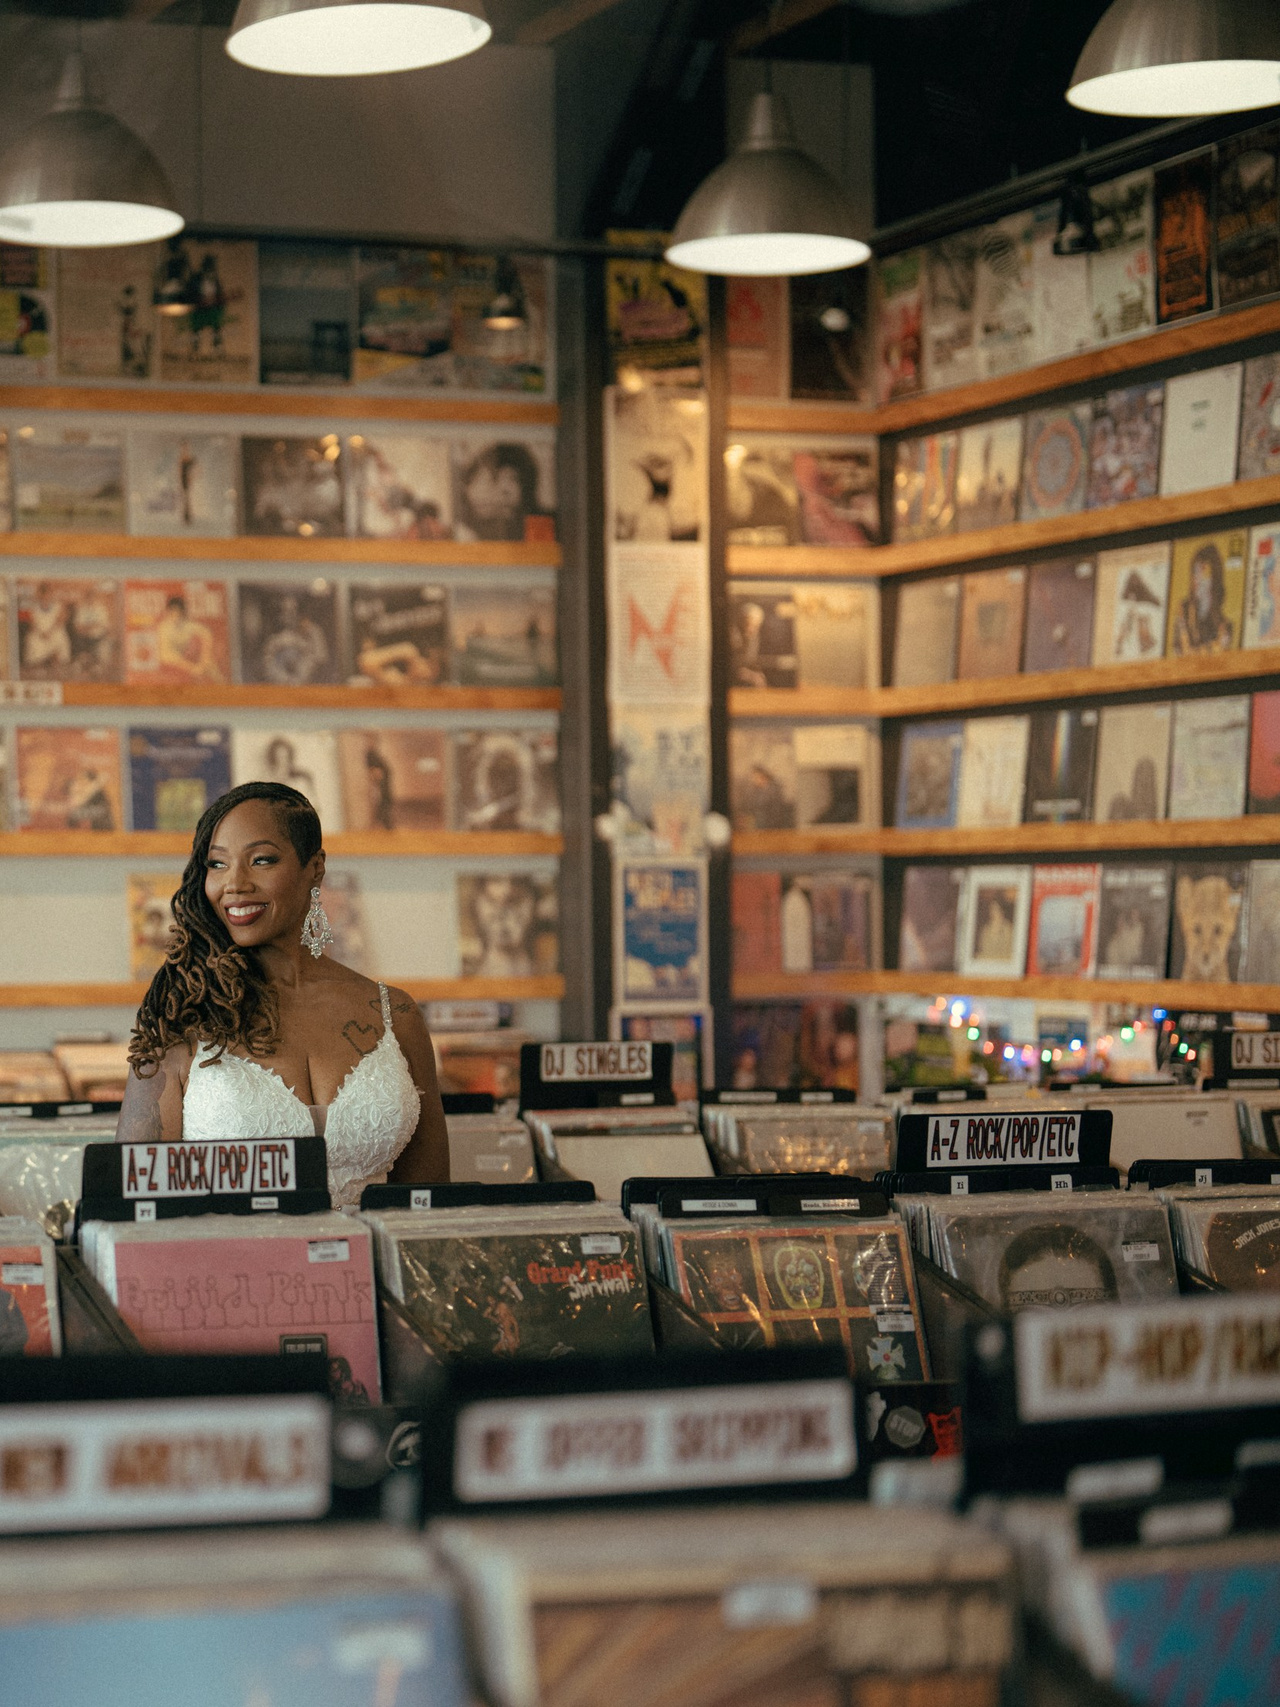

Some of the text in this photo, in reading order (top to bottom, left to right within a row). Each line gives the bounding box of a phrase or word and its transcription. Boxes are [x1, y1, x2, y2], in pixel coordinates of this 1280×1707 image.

[545, 1047, 648, 1076] DJ SINGLES
[1235, 1037, 1280, 1064] DJ SI
[931, 1117, 1076, 1162] A-Z ROCK/POP/ETC
[127, 1144, 289, 1193] A-Z ROCK/POP/ETC
[1198, 1175, 1207, 1184] Jj
[956, 1181, 965, 1189] Ii
[1055, 1180, 1068, 1189] Hh
[414, 1196, 428, 1207] Gg
[1234, 1229, 1256, 1250] JACK
[527, 1259, 635, 1284] Grand Funk
[266, 1270, 374, 1326] Pink
[570, 1271, 630, 1300] Survival
